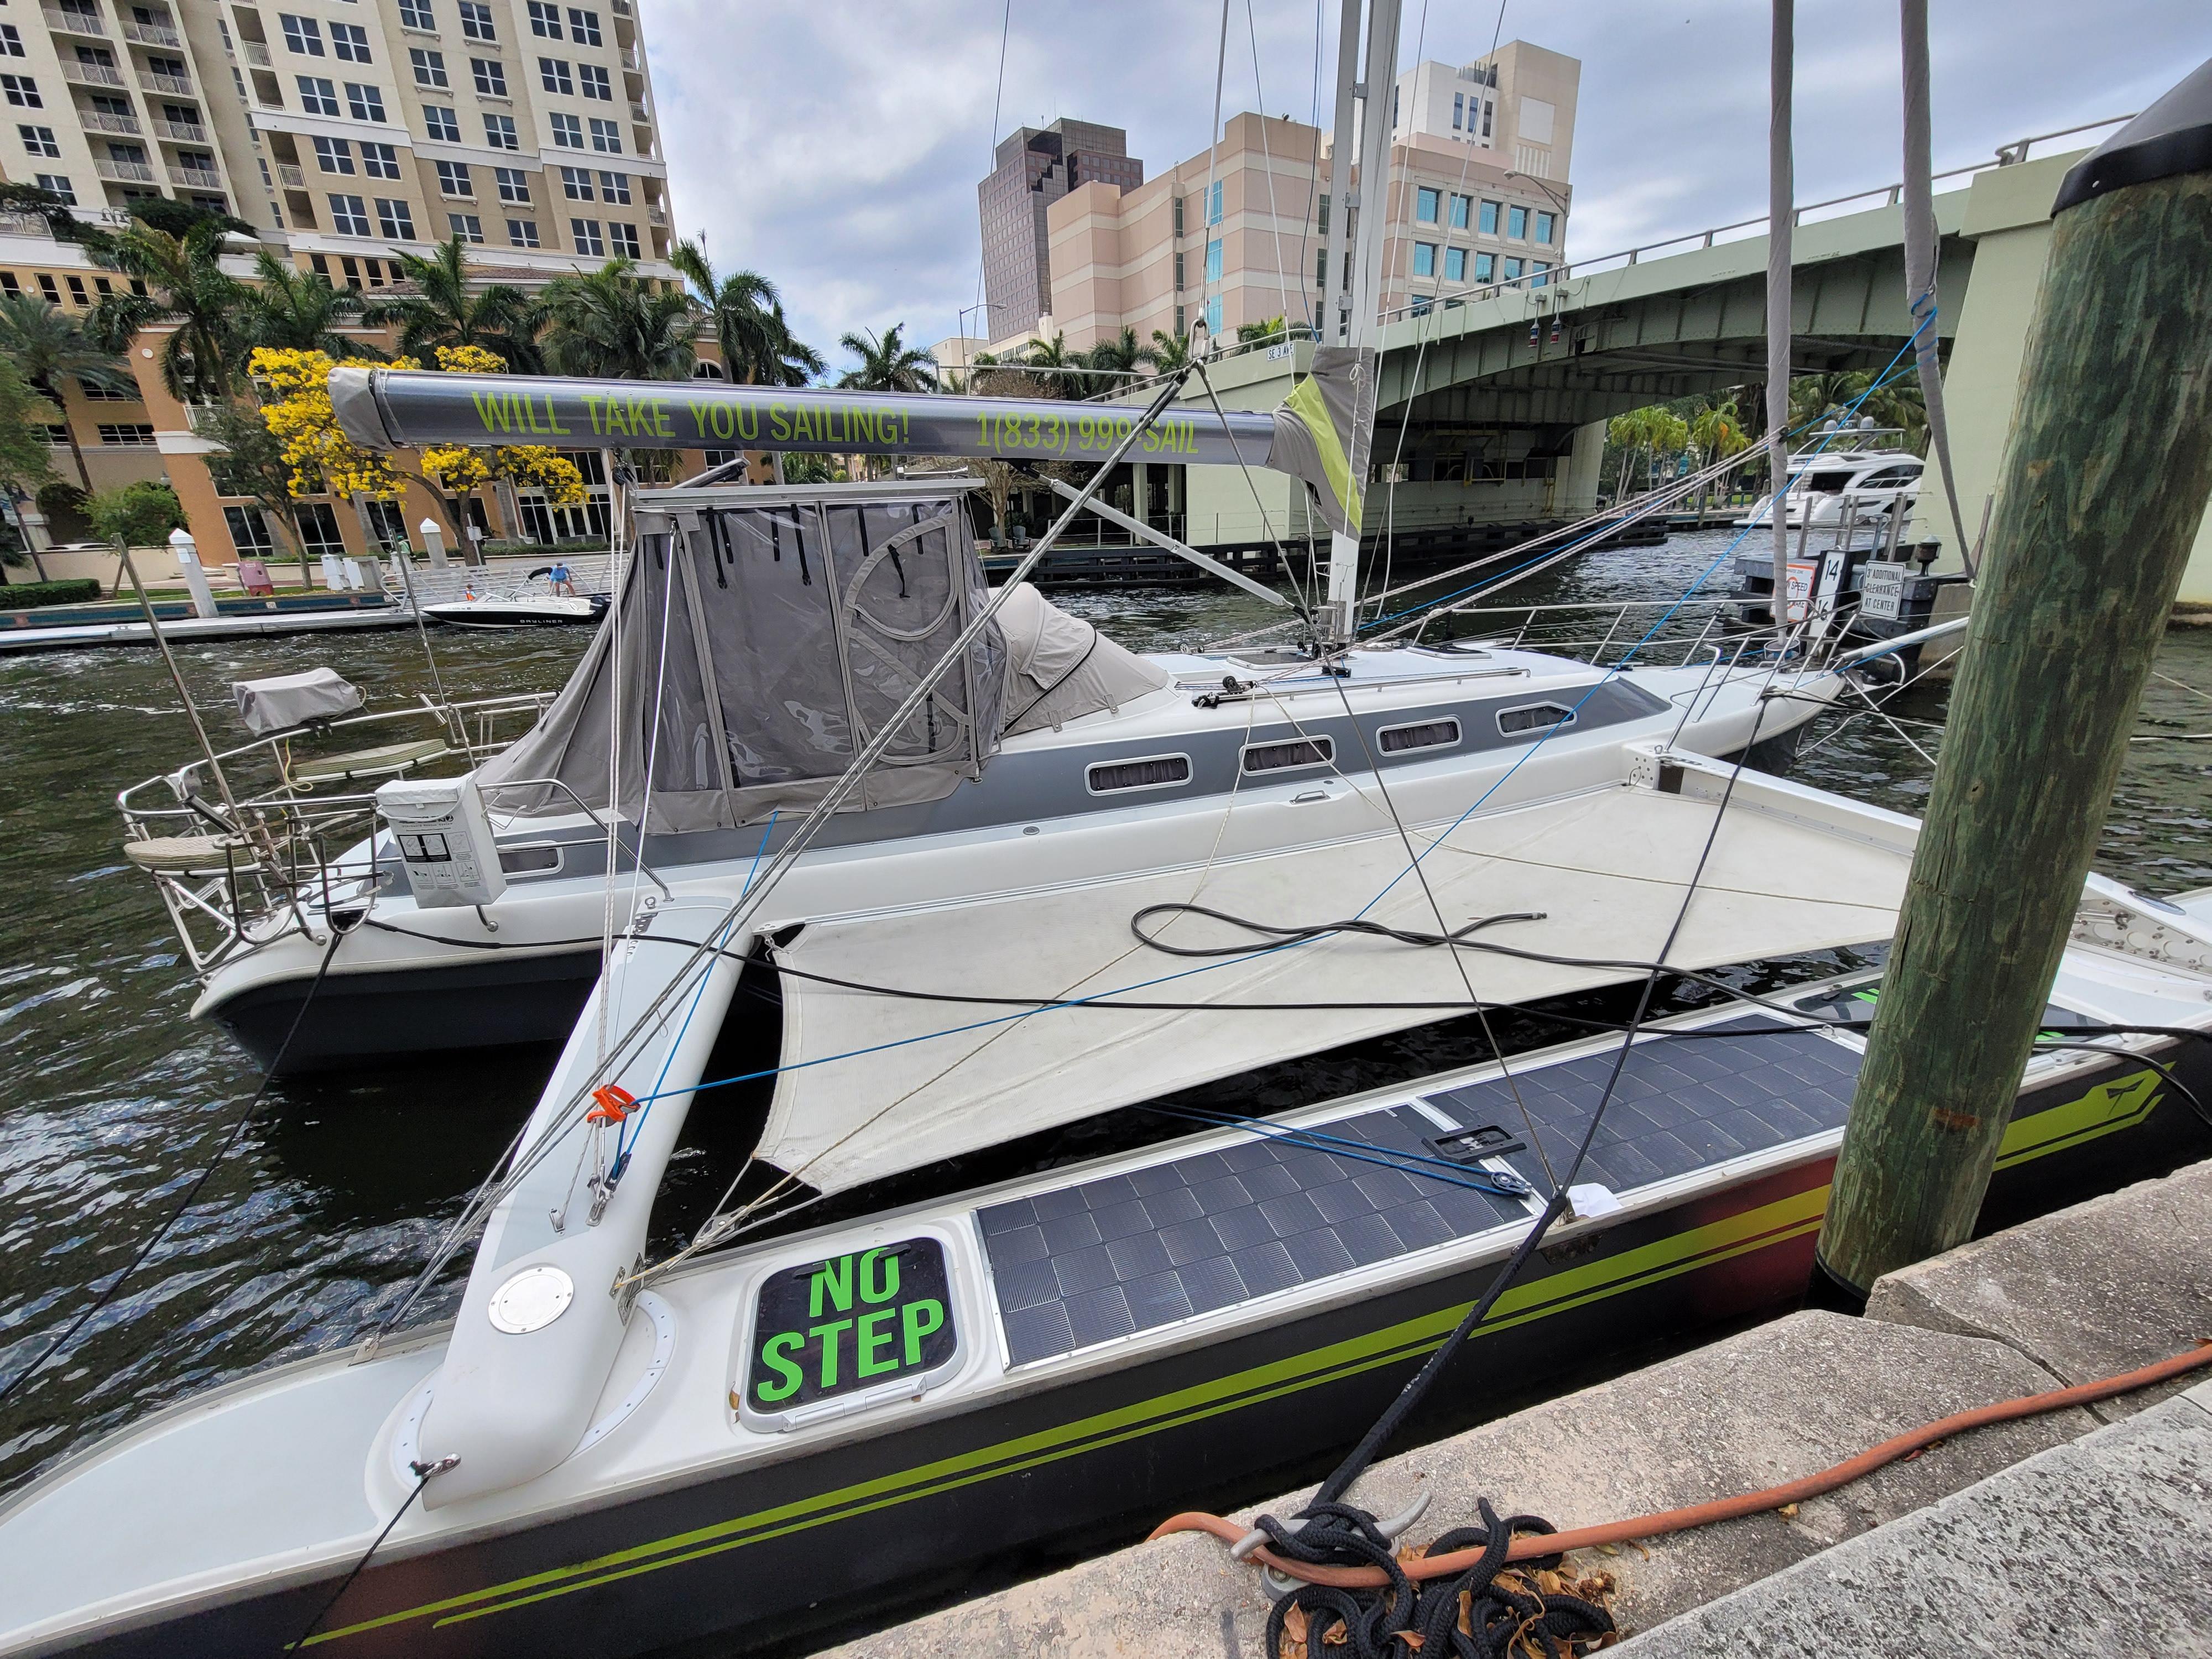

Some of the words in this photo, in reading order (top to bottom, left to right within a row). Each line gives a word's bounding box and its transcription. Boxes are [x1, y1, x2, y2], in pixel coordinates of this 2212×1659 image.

[1269, 348, 1275, 359] SE
[1277, 347, 1281, 357] 3
[471, 391, 571, 434] WILL
[581, 395, 676, 437] TAKE
[687, 399, 758, 440] YOU
[770, 402, 909, 444] SAILING!
[977, 411, 1070, 456] 1(833)
[1825, 560, 1839, 581] 14
[1872, 569, 1901, 582] ADDITIONAL
[1791, 581, 1808, 592] SPEED
[1866, 583, 1899, 597] CLEARANCE
[1865, 598, 1871, 607] AT
[1873, 599, 1895, 611] CENTER
[810, 1247, 899, 1318] NO
[758, 1299, 944, 1401] STEP
